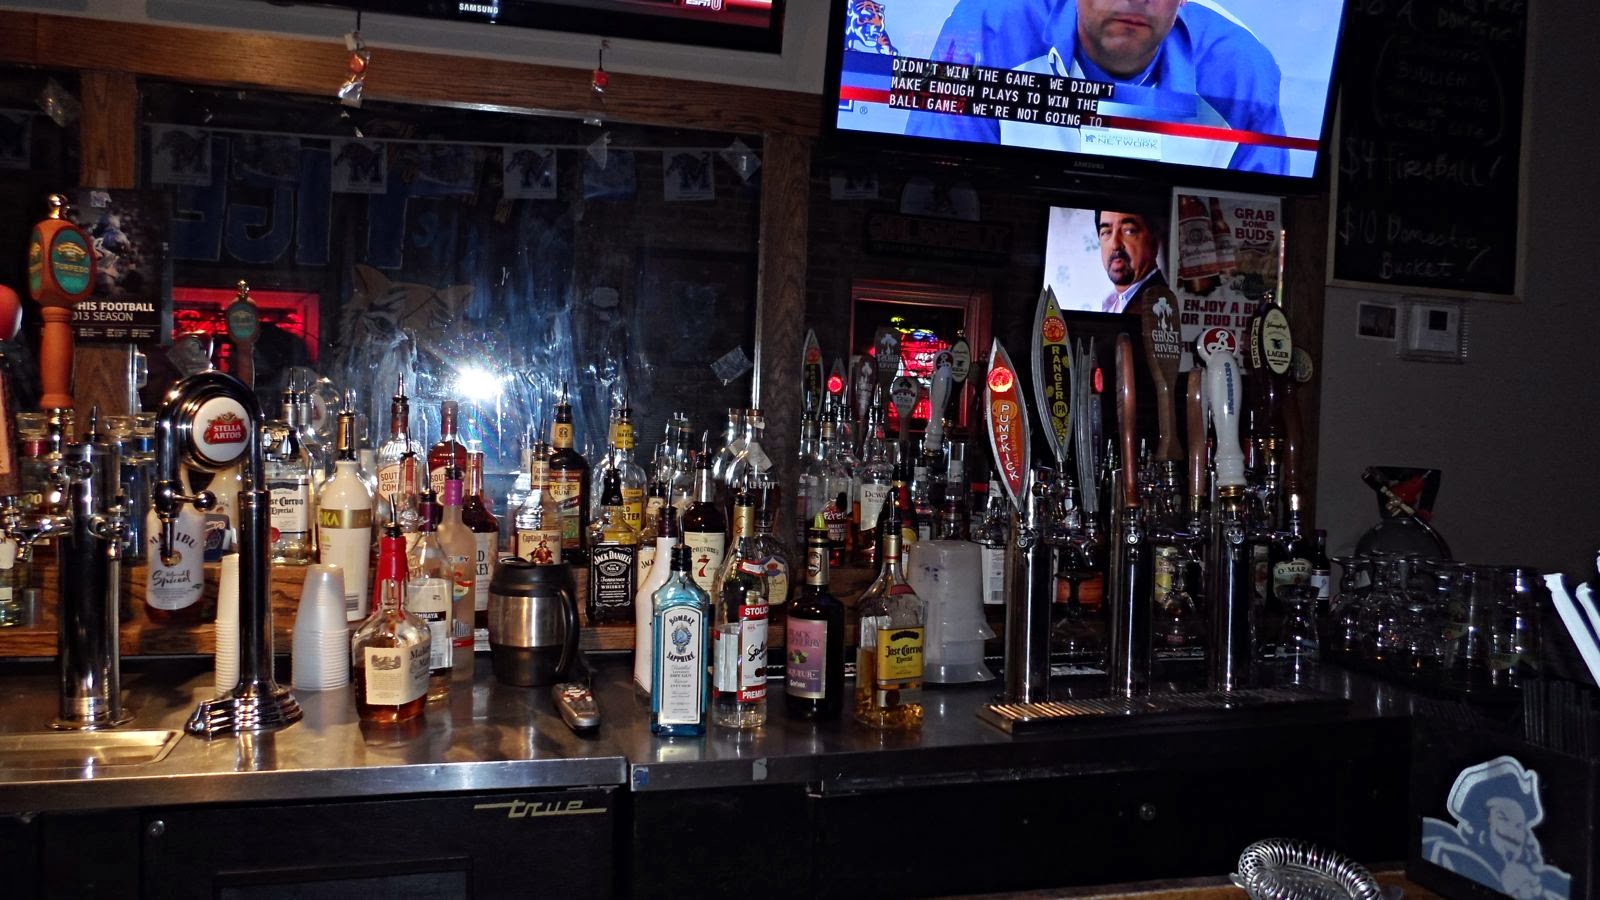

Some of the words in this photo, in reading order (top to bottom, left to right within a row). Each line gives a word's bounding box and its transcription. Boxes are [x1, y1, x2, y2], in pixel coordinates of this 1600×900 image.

[892, 59, 939, 76] DIDN'T
[946, 66, 968, 80] WIN
[978, 69, 999, 83] THE
[1006, 73, 1041, 88] GAME.
[1050, 77, 1064, 91] WE
[1070, 80, 1114, 97] DIDN'T
[891, 76, 921, 92] MAKE
[929, 81, 975, 98] ENOUGH
[982, 86, 1019, 102] PLAYS
[1027, 92, 1041, 105] TO
[1047, 94, 1069, 108] WIN
[1077, 97, 1098, 112] THE
[889, 94, 919, 109] BALL
[927, 98, 964, 113] GAME.
[973, 103, 1009, 119] WE'RE
[1017, 107, 1038, 121] NOT
[1045, 112, 1081, 126] GOING
[1089, 116, 1103, 127] TO
[1097, 138, 1158, 148] NETWORK
[1234, 208, 1275, 222] GRAB
[1242, 220, 1268, 229] SOME
[1235, 228, 1275, 242] BUDS
[76, 302, 97, 311] HIS
[101, 302, 155, 312] FOOTBALL
[1184, 299, 1226, 313] ENJOY
[1230, 301, 1240, 314] A
[93, 312, 134, 321] SEASON
[1182, 313, 1199, 325] OR
[1204, 314, 1231, 327] BUD
[1235, 315, 1247, 328] LI
[1151, 329, 1180, 343] GHOST
[1155, 343, 1180, 353] RIVER
[1252, 319, 1260, 366] LAGER
[1267, 350, 1288, 358] LAGER
[1051, 346, 1064, 400] RANGER
[1053, 404, 1067, 414] IPA
[212, 424, 242, 432] STELLA
[212, 431, 242, 439] ARTOIS
[998, 404, 1020, 481] PUMPKICK
[380, 472, 398, 482] SOUT
[431, 474, 445, 482] SOU
[382, 484, 398, 492] COM
[279, 496, 304, 507] Cuervo
[622, 512, 640, 521] RTER
[148, 531, 198, 549] MAIBU
[594, 553, 609, 566] JACK
[608, 550, 632, 565] DANIEL'S
[668, 614, 695, 626] BOMBAY
[666, 651, 695, 662] SAPPHIRE
[885, 645, 900, 657] Jose
[900, 645, 923, 656] Cuervo
[498, 800, 592, 818] true
